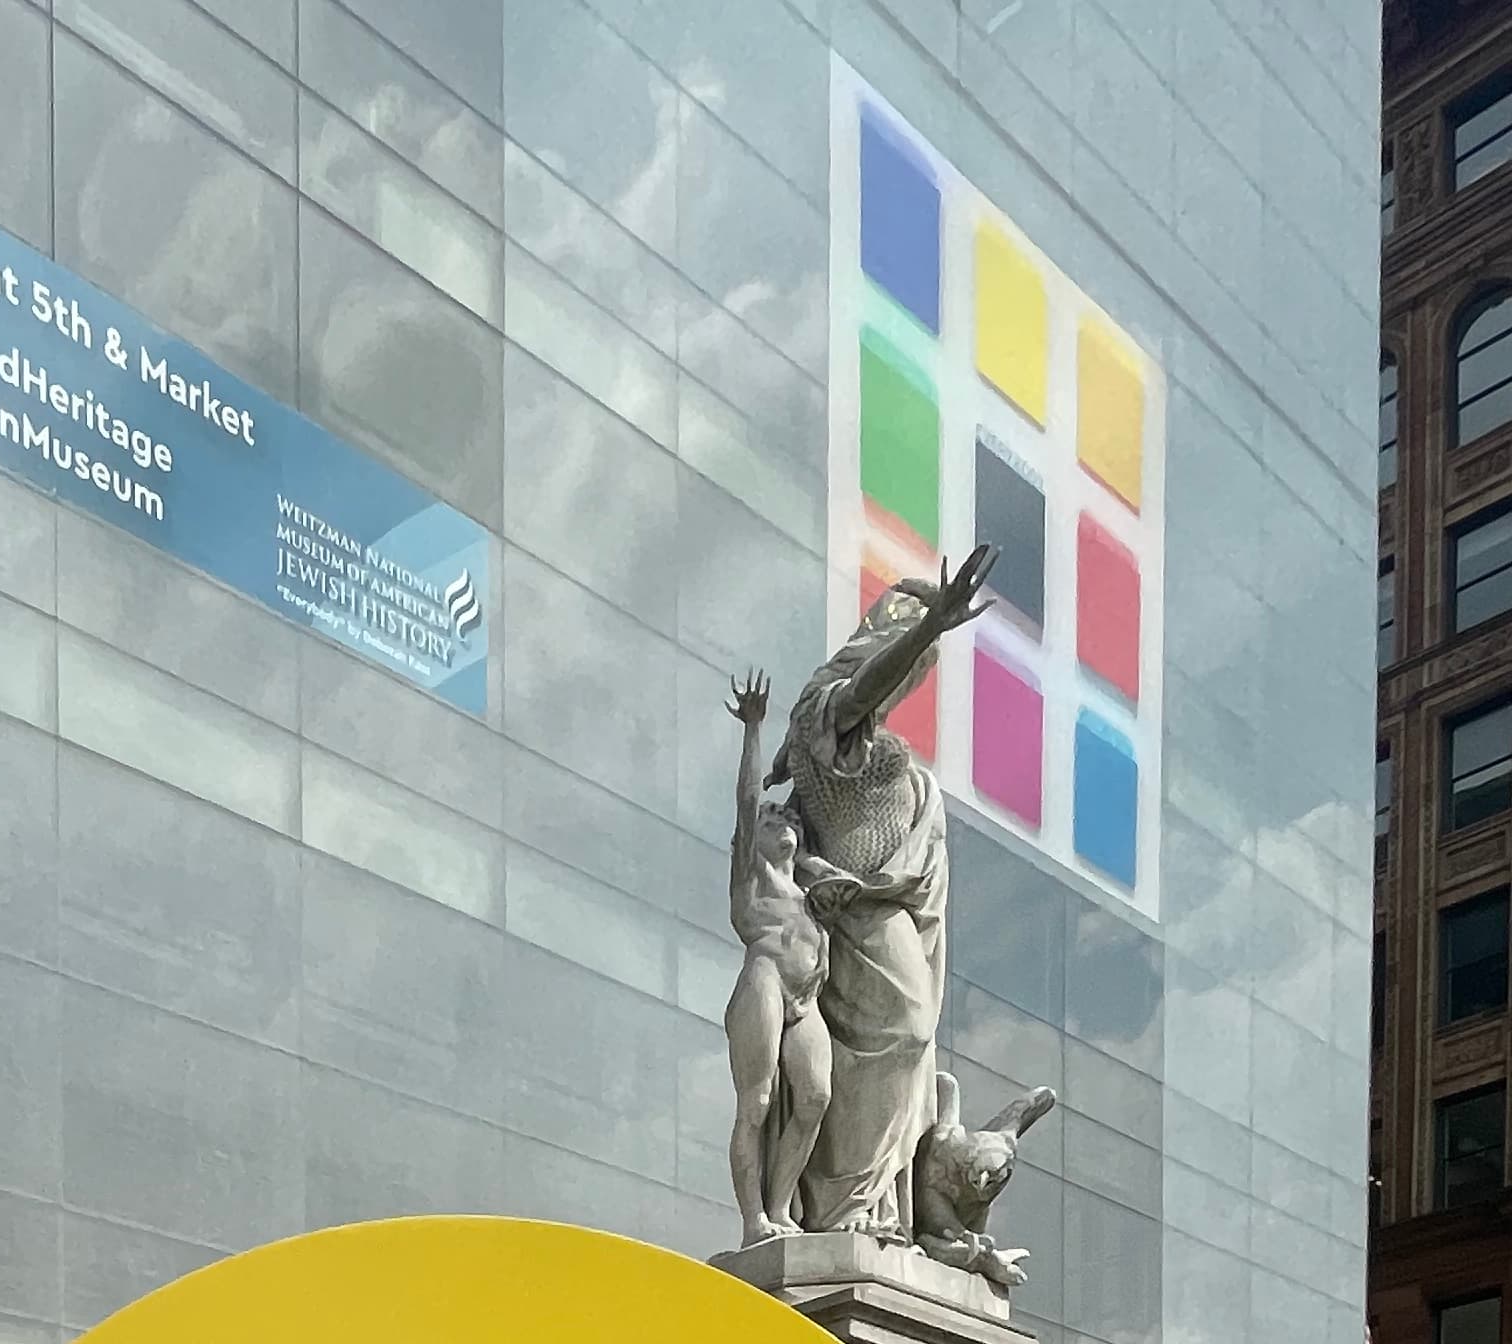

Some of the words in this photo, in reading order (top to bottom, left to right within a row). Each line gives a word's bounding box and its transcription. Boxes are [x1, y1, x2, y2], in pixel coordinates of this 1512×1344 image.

[31, 287, 93, 348] 5th
[104, 327, 129, 370] &
[139, 345, 256, 448] Market
[276, 522, 344, 576] MUSEUM
[347, 564, 369, 586] OF
[371, 576, 449, 631] AMERICAN
[276, 547, 356, 617] JEWISH
[362, 594, 452, 662] HISTORY
[277, 493, 362, 557] WEITZMAN
[365, 547, 441, 604] NATIONAL
